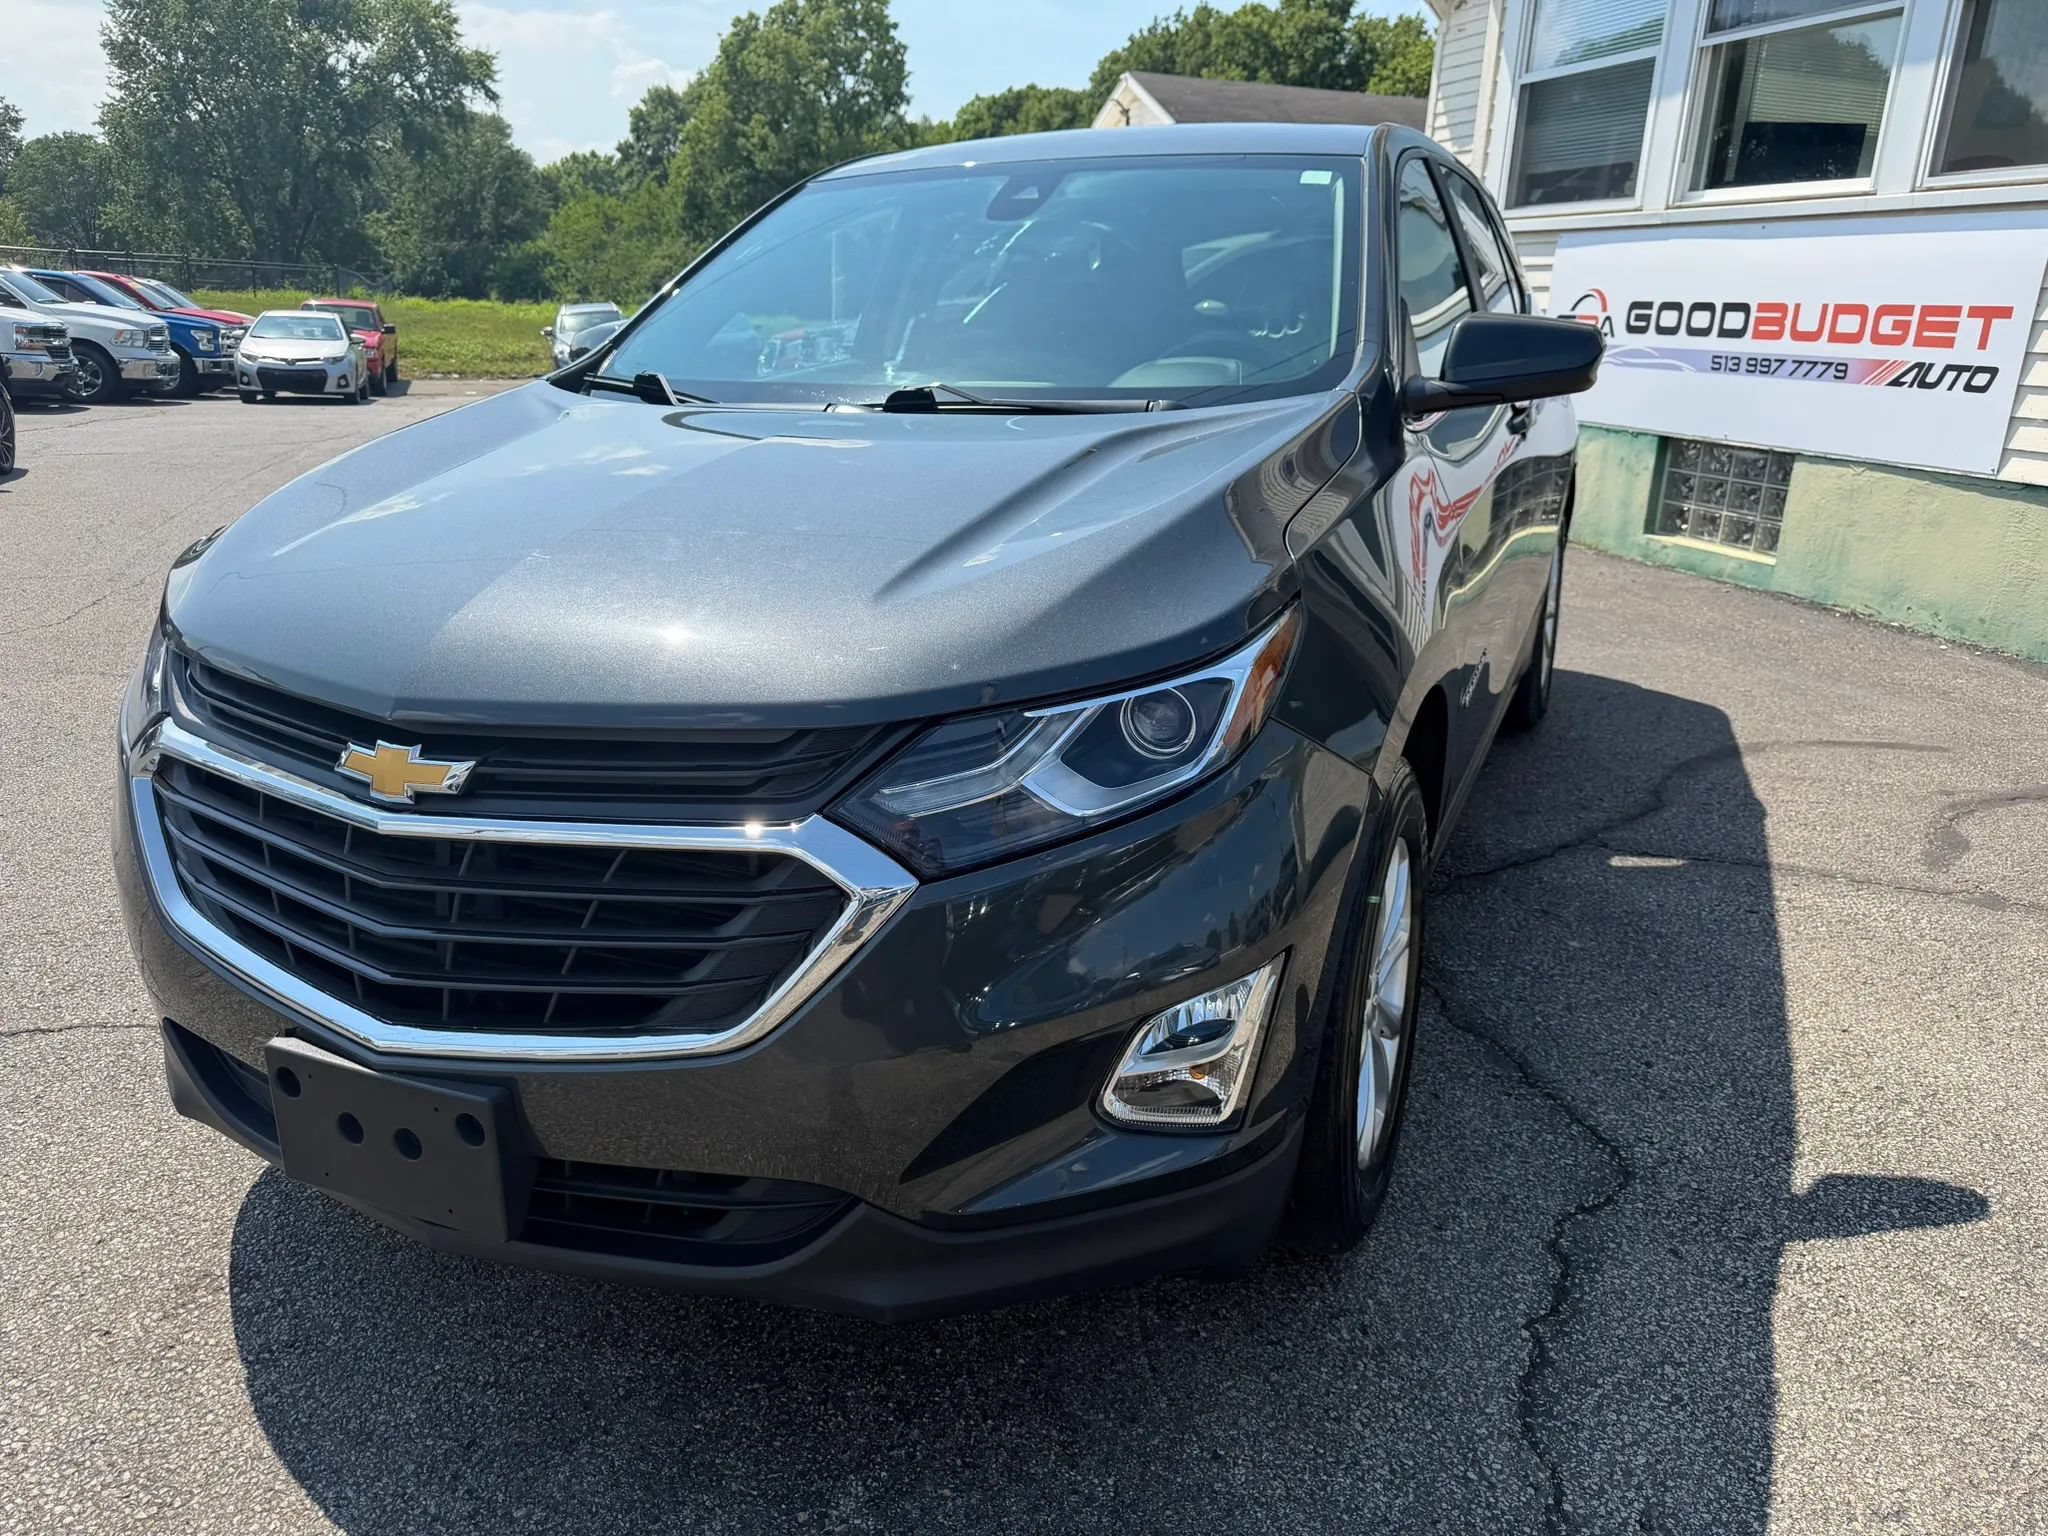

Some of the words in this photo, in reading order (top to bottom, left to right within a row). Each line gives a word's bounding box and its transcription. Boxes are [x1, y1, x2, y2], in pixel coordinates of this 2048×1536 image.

[1710, 355, 1741, 372] 513
[1745, 357, 1786, 376] 997
[1788, 360, 1849, 380] 7779
[1886, 361, 2000, 394] AUTO
